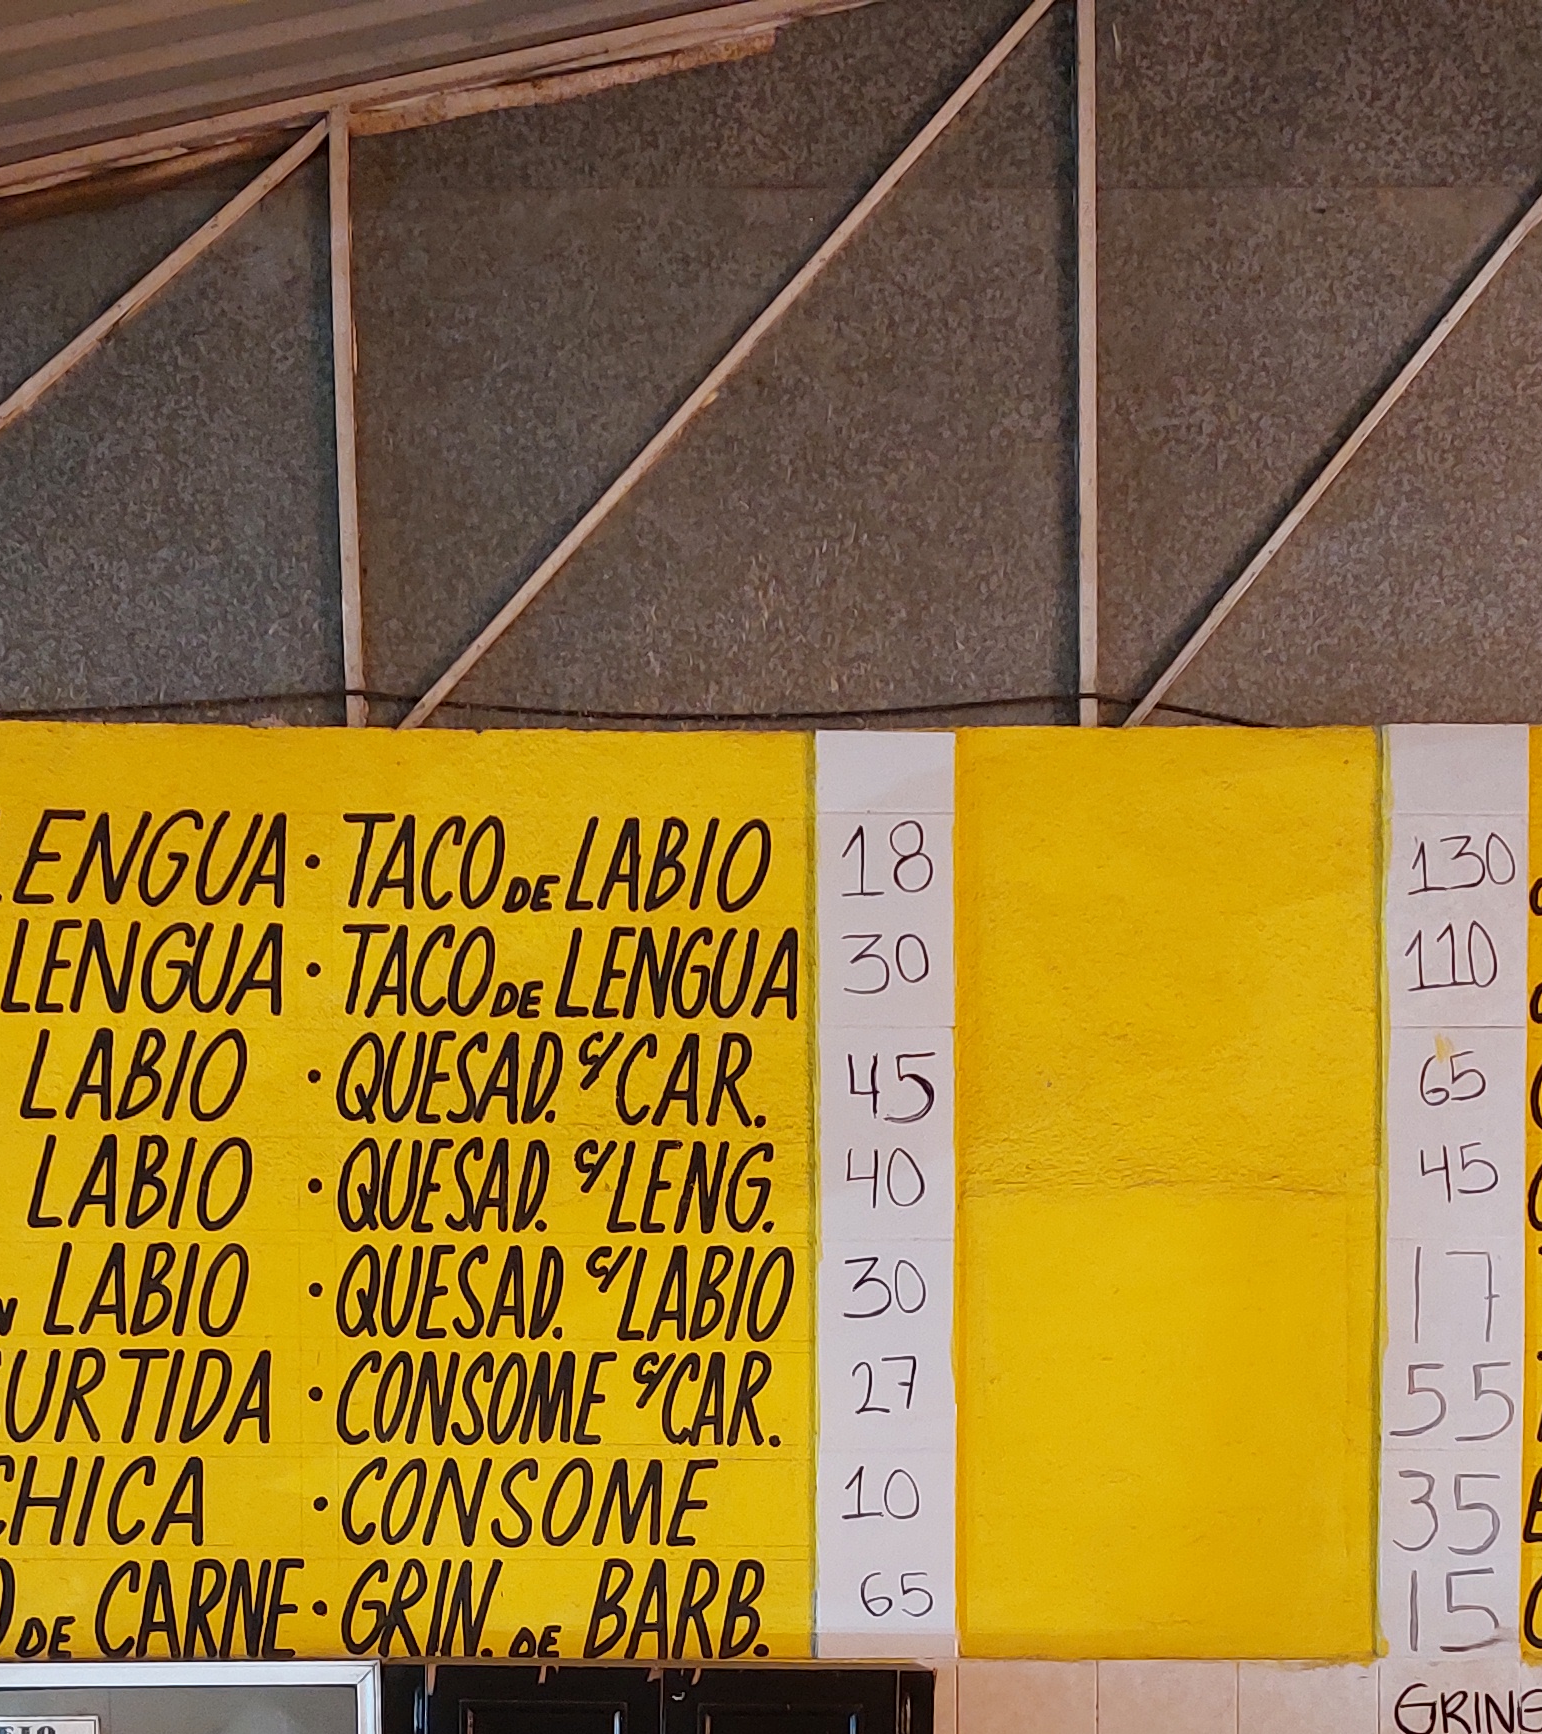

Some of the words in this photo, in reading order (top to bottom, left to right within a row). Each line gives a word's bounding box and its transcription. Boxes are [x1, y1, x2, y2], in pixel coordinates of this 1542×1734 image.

[343, 813, 505, 910] TACO
[565, 817, 771, 913] LABIO
[842, 821, 933, 896] 18
[1408, 833, 1515, 895] 130
[0, 918, 283, 1016] LENGUA
[343, 924, 495, 1018] TACO
[555, 926, 798, 1020] LENGUA
[842, 934, 929, 994] 30
[1405, 921, 1497, 991] 110
[20, 1028, 247, 1121] LABIO
[336, 1031, 563, 1124] QUESAD.
[848, 1052, 935, 1123] 45
[1420, 1051, 1486, 1106] 65
[27, 1134, 252, 1231] LABIO
[338, 1137, 550, 1233] QUESAD.
[847, 1148, 925, 1208] 40
[1420, 1142, 1498, 1203] 45
[43, 1242, 249, 1337] LABIO
[336, 1244, 563, 1340] QUESAD.
[844, 1257, 926, 1318] 30
[1415, 1247, 1499, 1343] 17
[336, 1351, 617, 1446] CONSOME
[852, 1356, 916, 1414] 27
[1390, 1362, 1514, 1441] 55
[342, 1457, 718, 1547] CONSOME
[842, 1466, 919, 1519] 10
[1393, 1470, 1500, 1555] 35
[14, 1614, 76, 1659] DE
[94, 1557, 306, 1659] CARNE
[342, 1559, 503, 1658] GRIN.
[583, 1558, 769, 1659] BARB.
[861, 1572, 933, 1617] 65
[1410, 1568, 1501, 1652] 15
